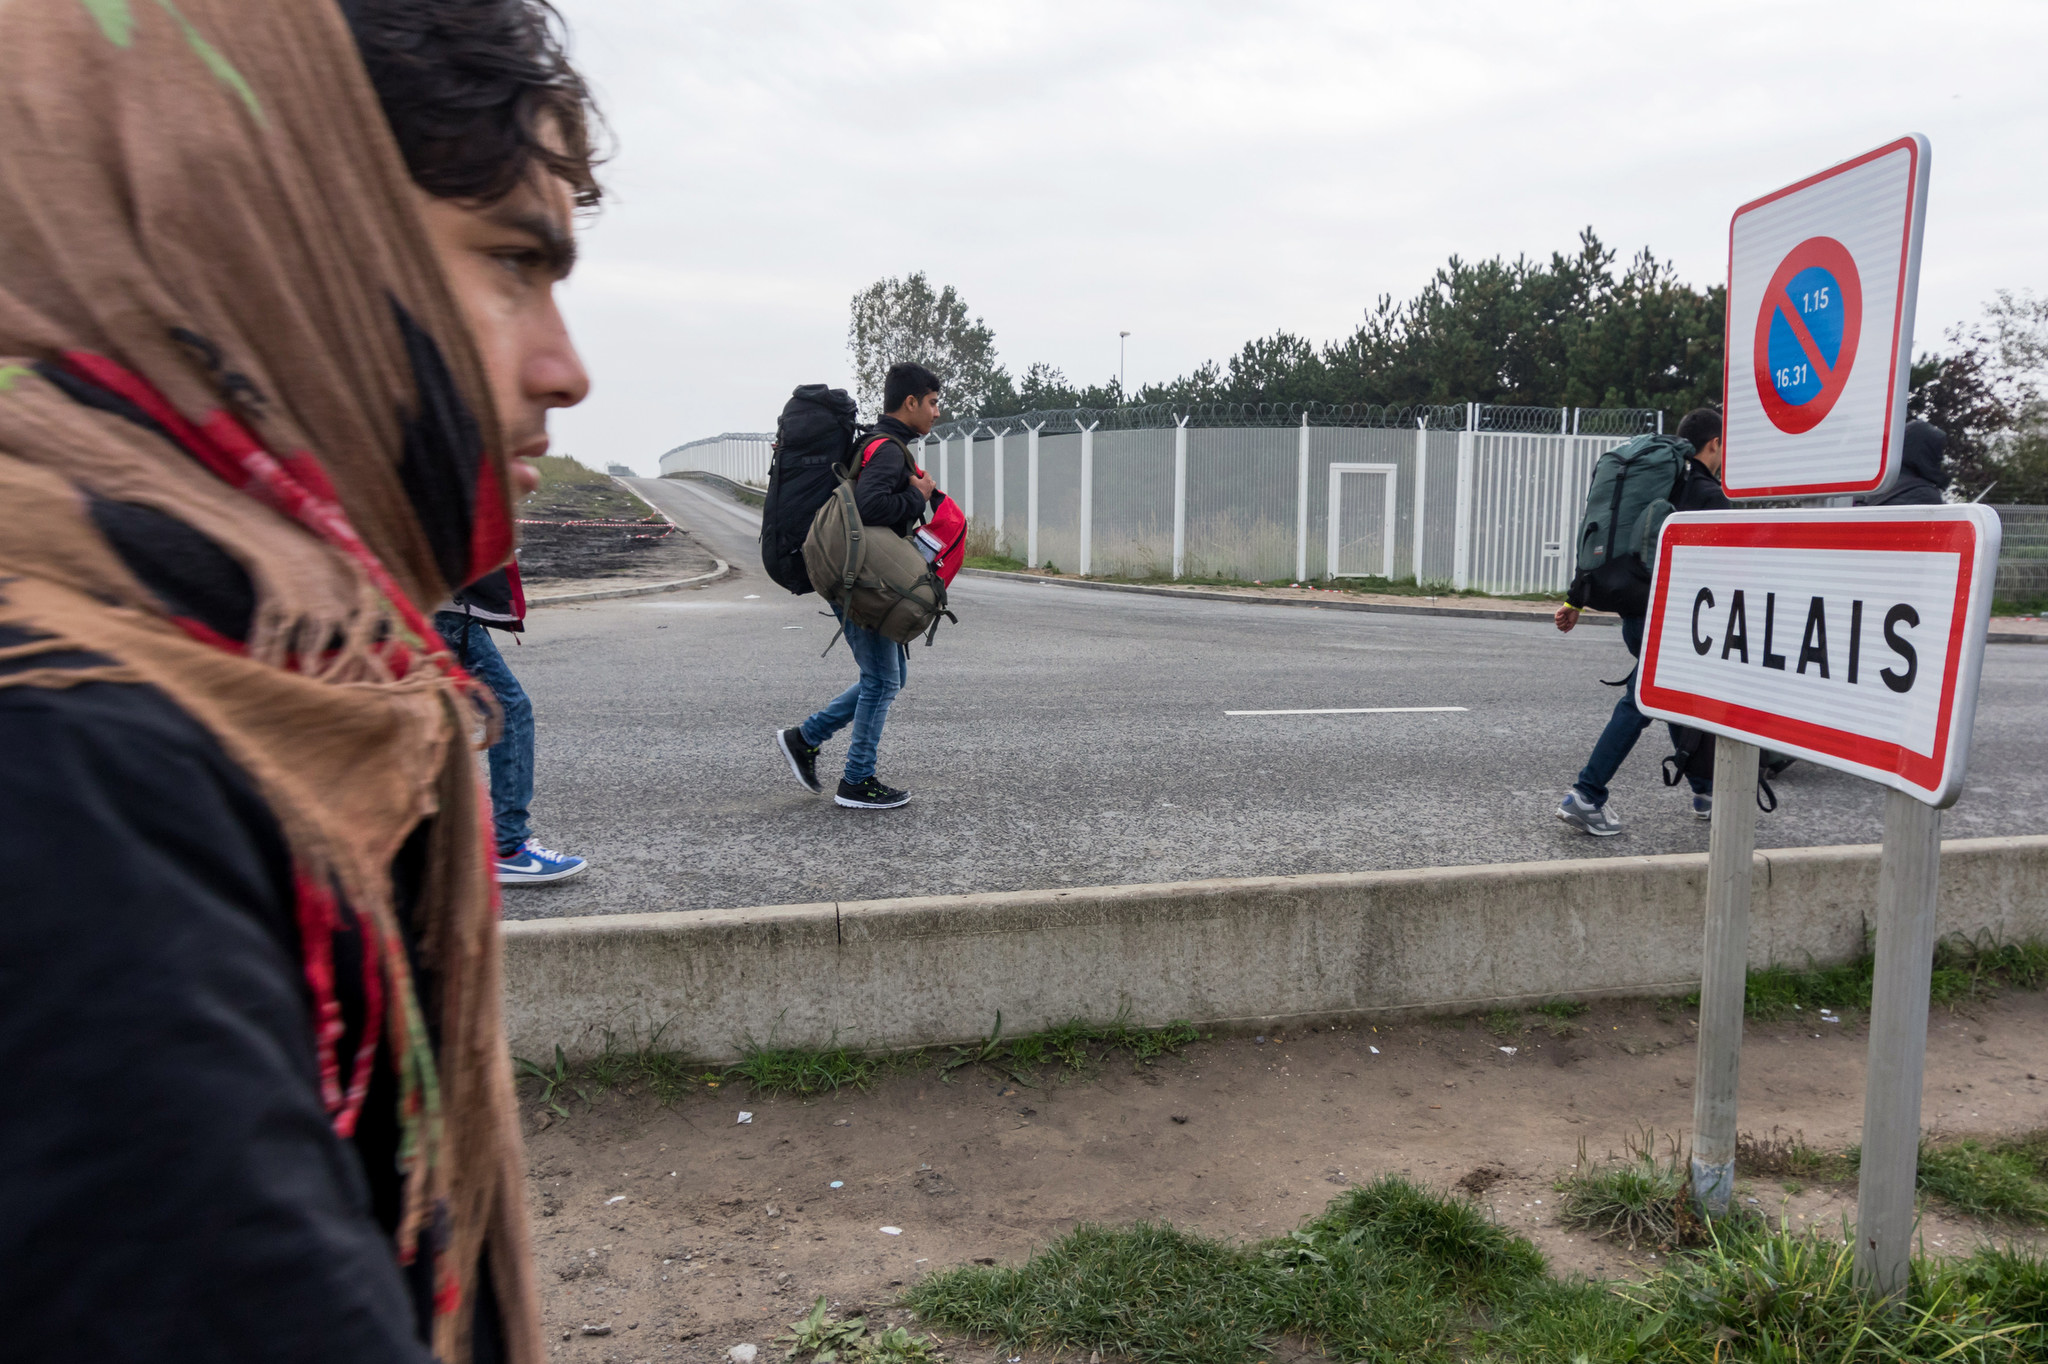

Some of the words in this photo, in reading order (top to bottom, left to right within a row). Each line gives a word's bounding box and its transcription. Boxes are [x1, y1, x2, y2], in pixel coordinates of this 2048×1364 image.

[1803, 287, 1829, 313] 1.15
[1776, 364, 1807, 389] 16.31
[1691, 587, 1920, 693] CALAIS
